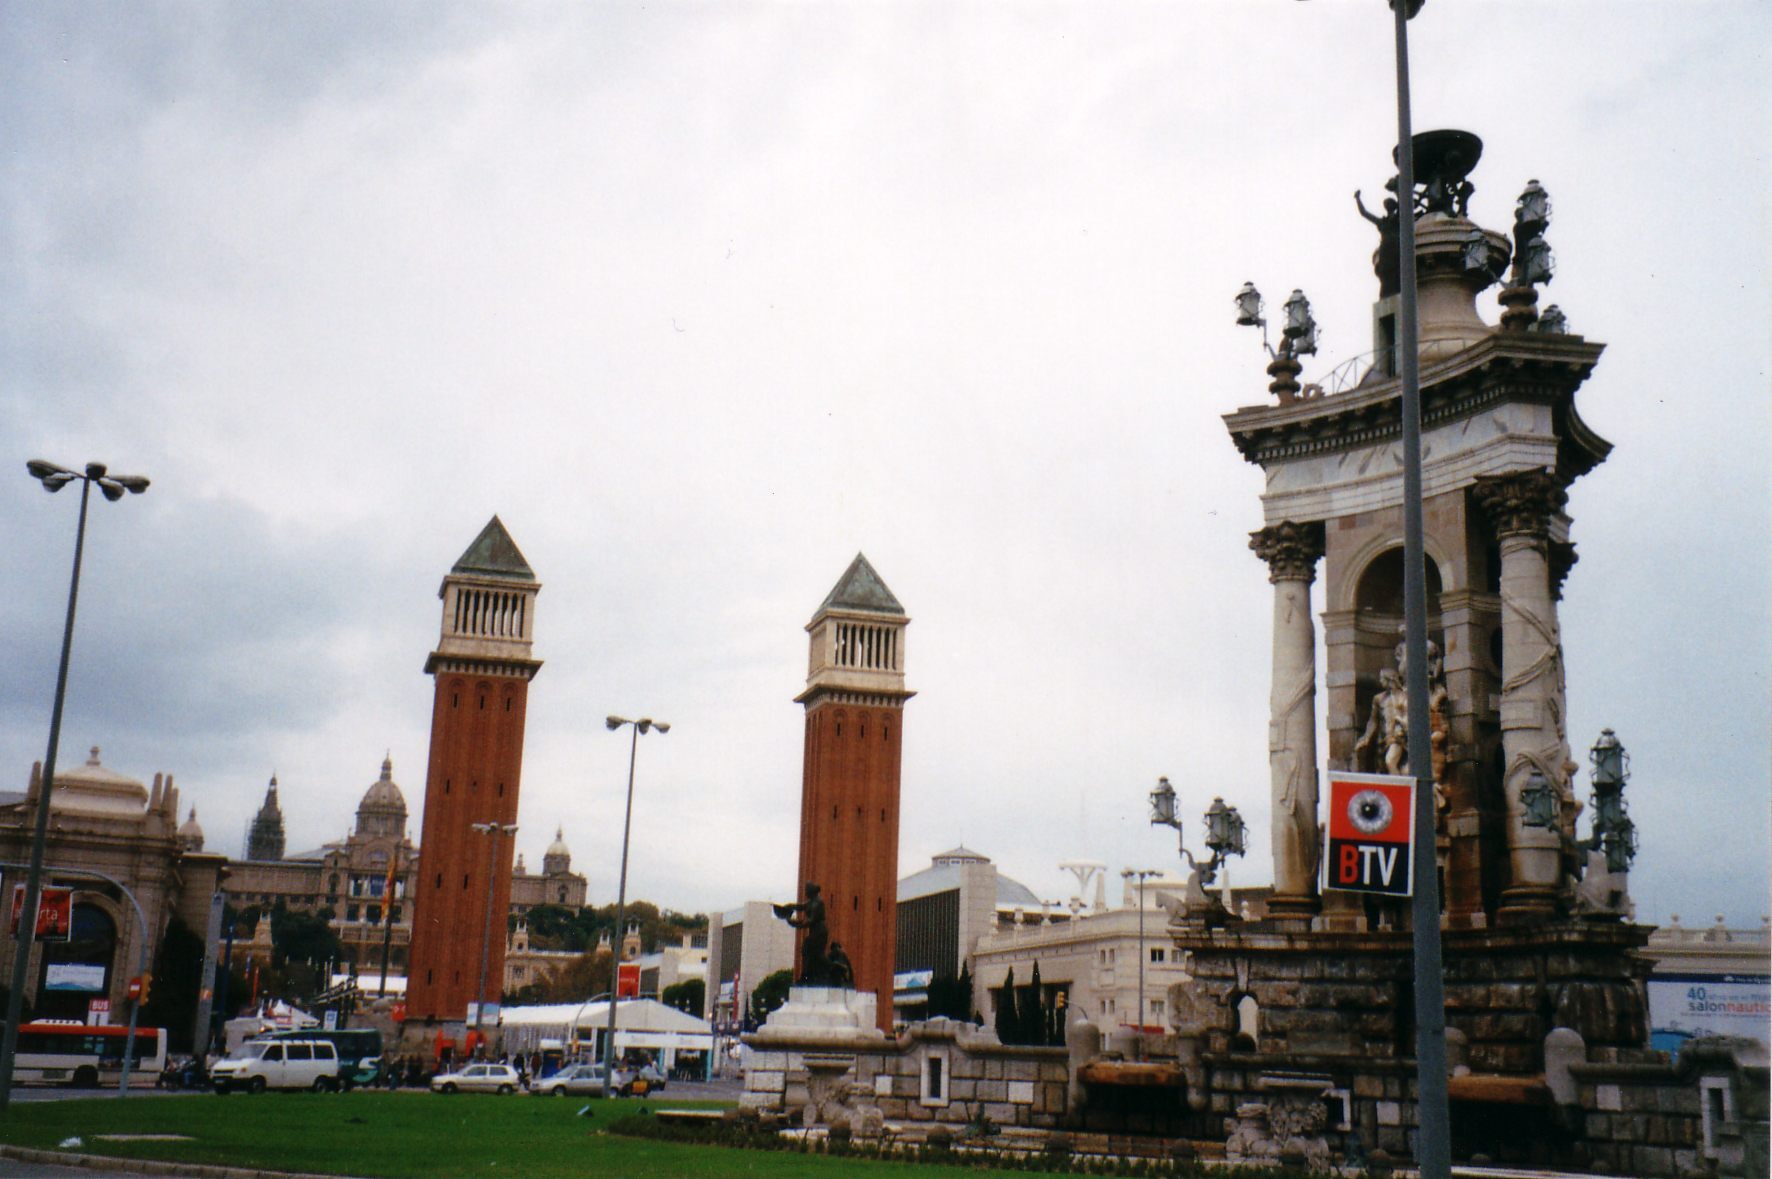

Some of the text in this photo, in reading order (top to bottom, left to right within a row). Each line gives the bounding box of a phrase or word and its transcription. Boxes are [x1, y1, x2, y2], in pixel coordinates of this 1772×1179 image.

[1339, 843, 1398, 886] BTV
[1687, 987, 1706, 1000] 40
[92, 1000, 109, 1010] BUS
